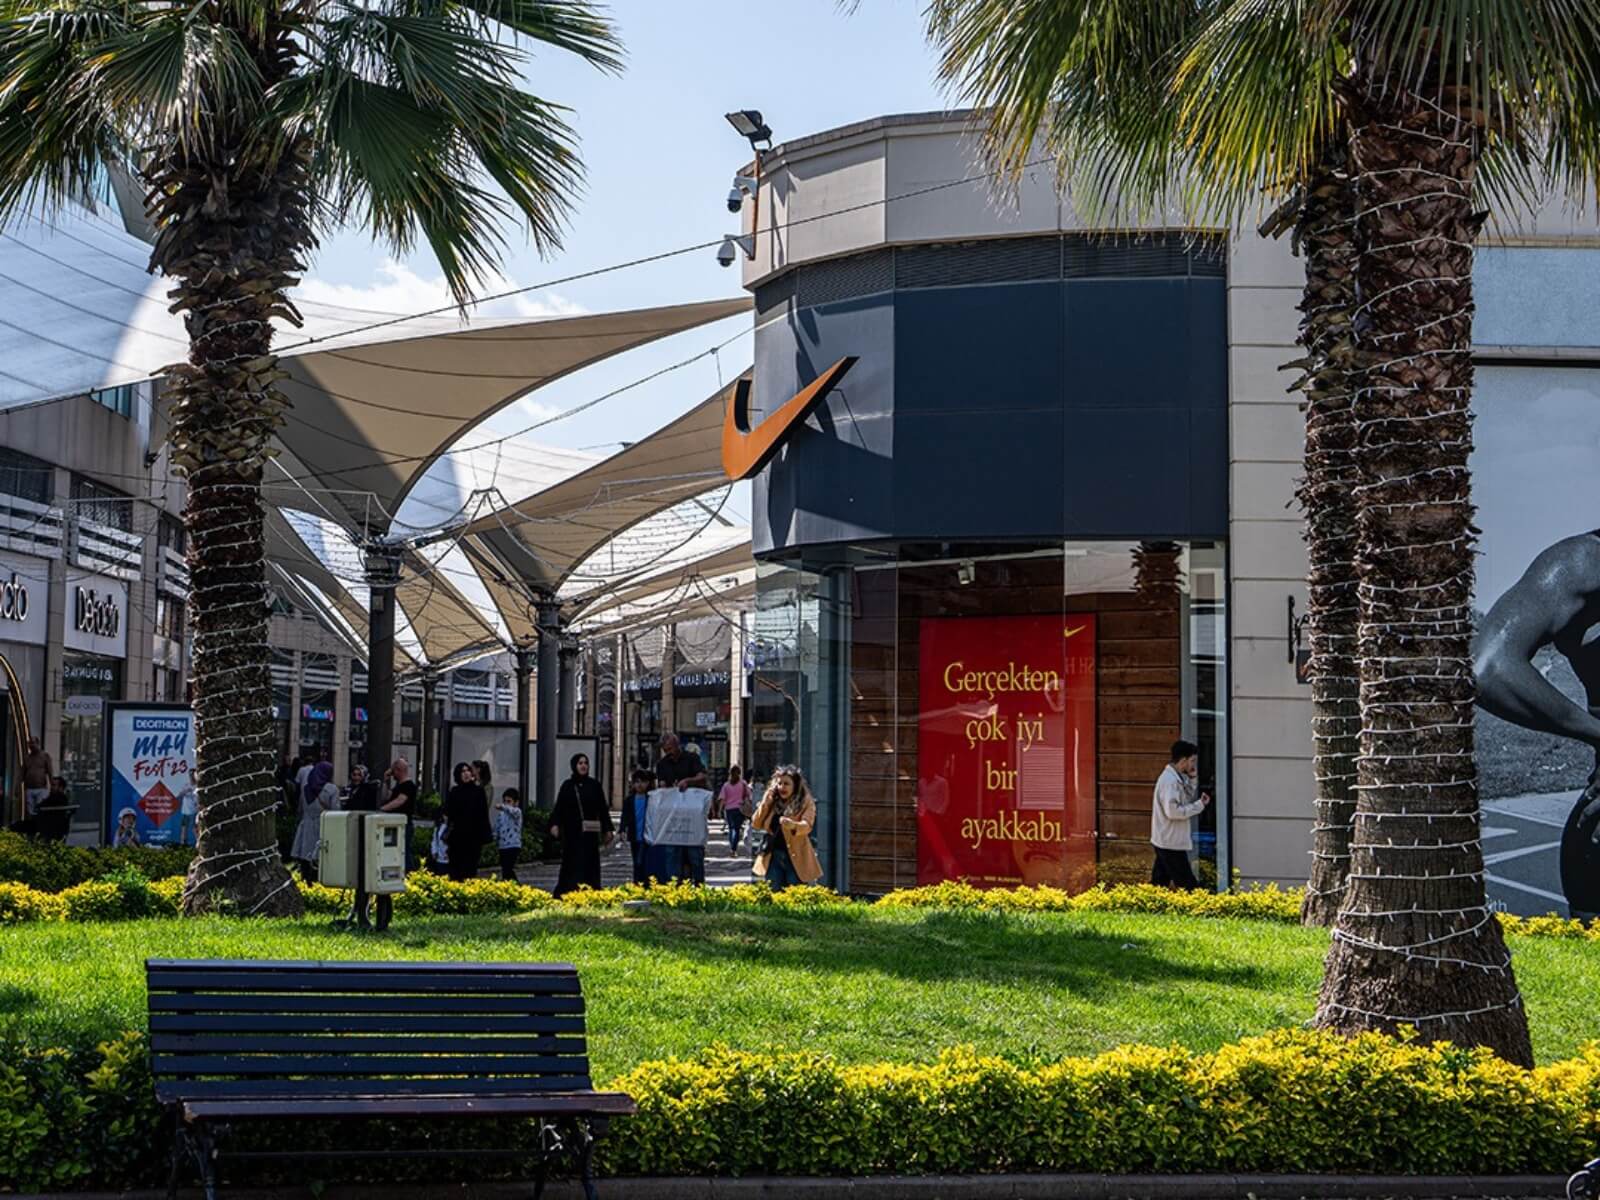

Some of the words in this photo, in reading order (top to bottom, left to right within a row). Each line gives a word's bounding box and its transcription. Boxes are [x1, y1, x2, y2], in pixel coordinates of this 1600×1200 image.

[944, 662, 1060, 700] Gerçekten
[136, 719, 186, 729] DECATHLON
[965, 711, 1007, 749] çok
[1016, 712, 1044, 751] iyi
[986, 760, 1017, 790] bir
[960, 810, 1067, 849] ayakkabı.
